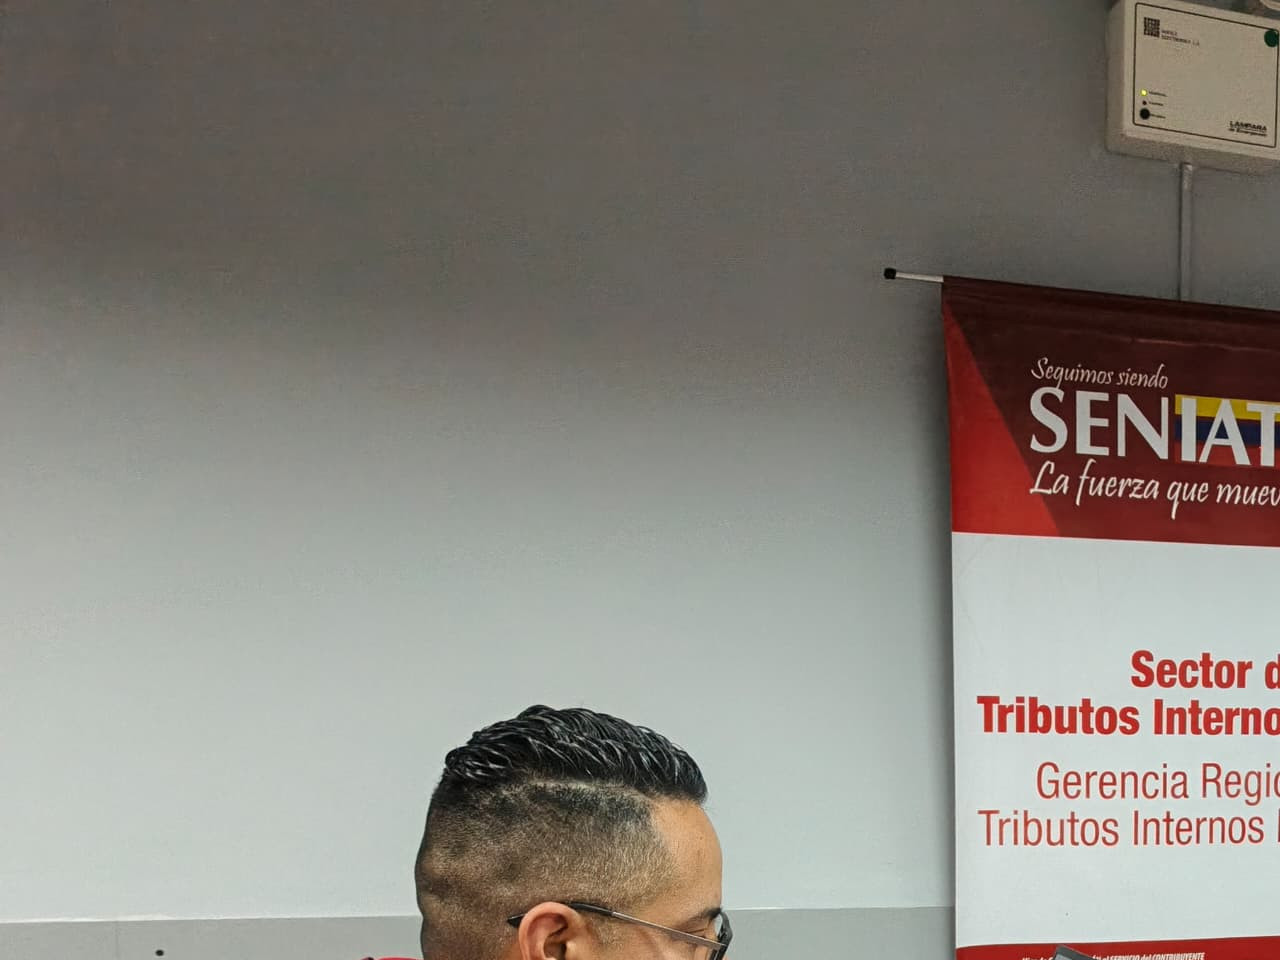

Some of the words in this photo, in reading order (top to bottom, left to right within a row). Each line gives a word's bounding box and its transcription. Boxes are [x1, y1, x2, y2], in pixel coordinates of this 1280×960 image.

[1031, 357, 1114, 388] Seguimos
[1116, 364, 1169, 389] siendo
[1029, 460, 1069, 495] La
[1074, 470, 1160, 507] fuerza
[1166, 480, 1209, 520] que
[1130, 649, 1253, 690] Sector
[976, 695, 1140, 735] Tributos
[1035, 761, 1189, 800] Gerencia
[977, 809, 1120, 847] Tributos
[1132, 809, 1265, 845] Internos
